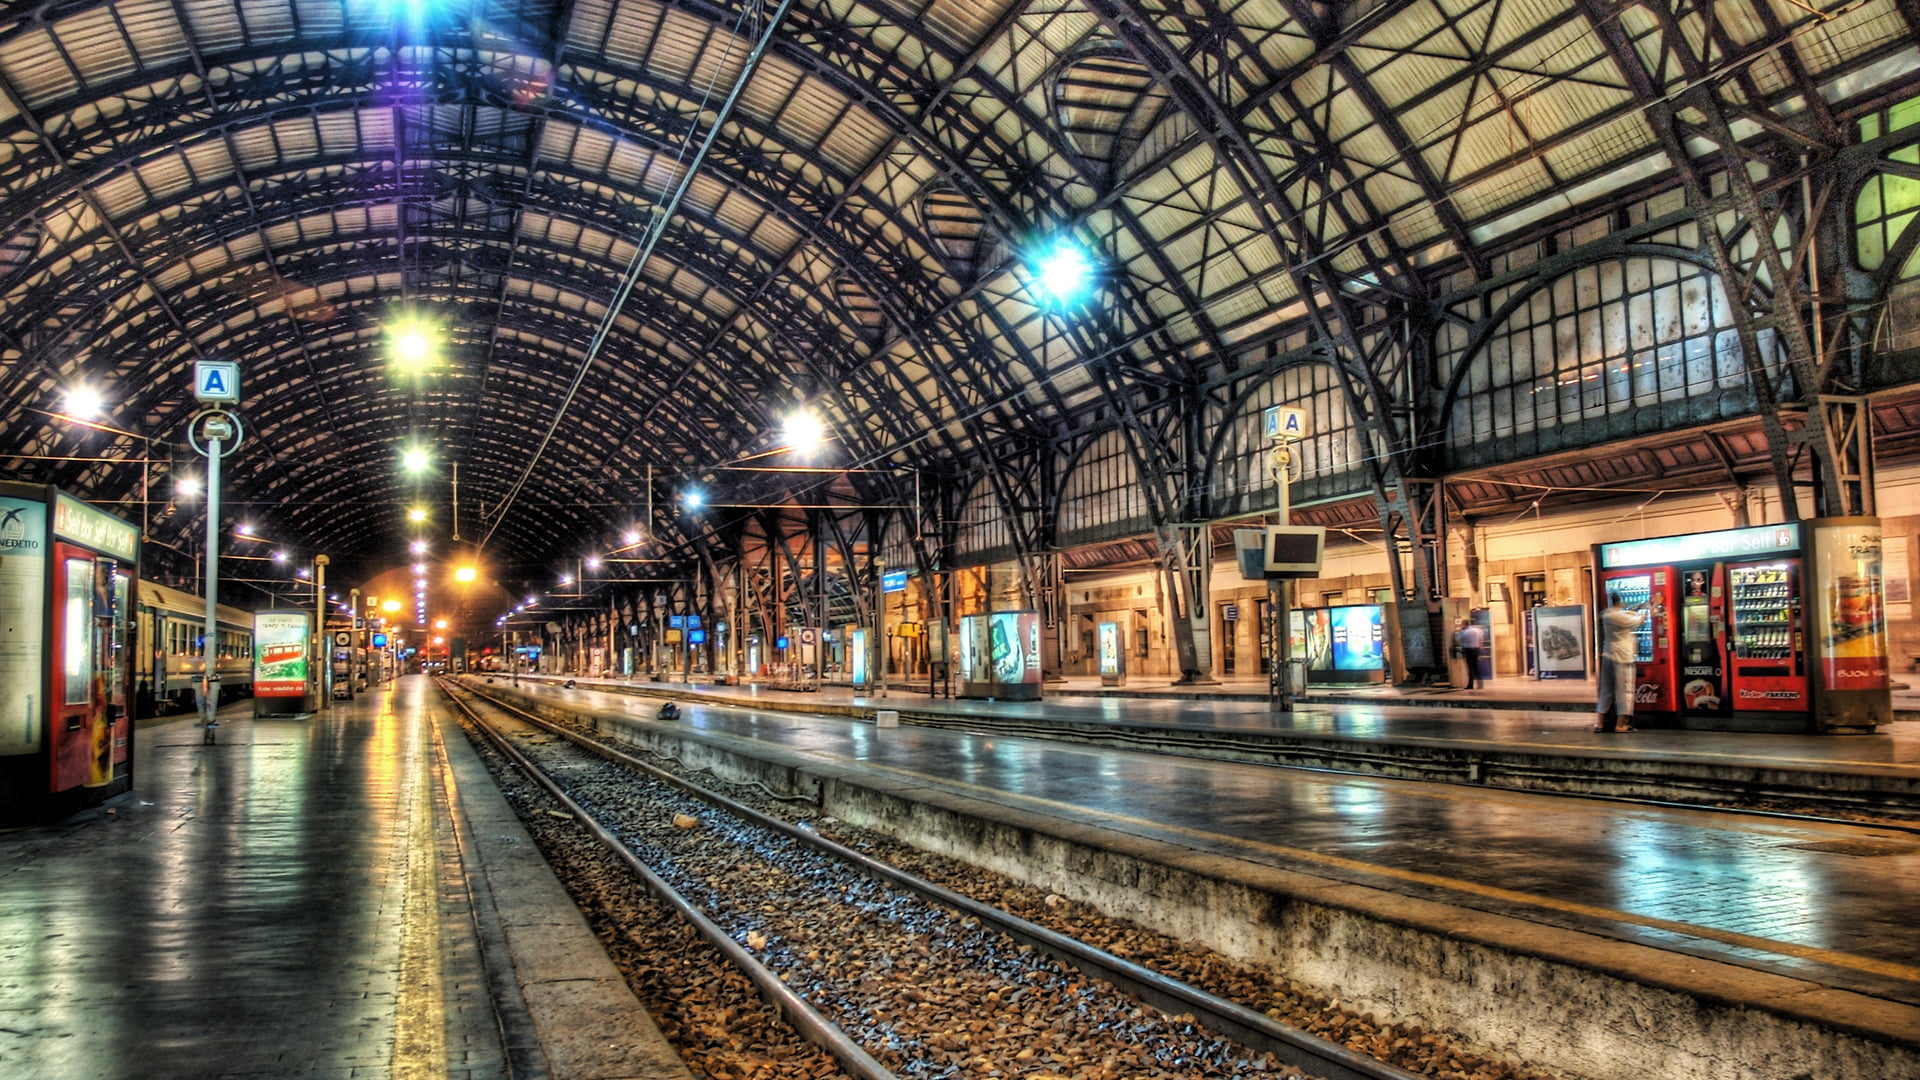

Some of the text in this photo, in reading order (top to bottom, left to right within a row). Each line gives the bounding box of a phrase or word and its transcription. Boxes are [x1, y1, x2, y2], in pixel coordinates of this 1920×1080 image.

[204, 370, 226, 392] A
[1269, 414, 1276, 431] A
[1286, 414, 1299, 431] A
[1741, 532, 1771, 550] Self
